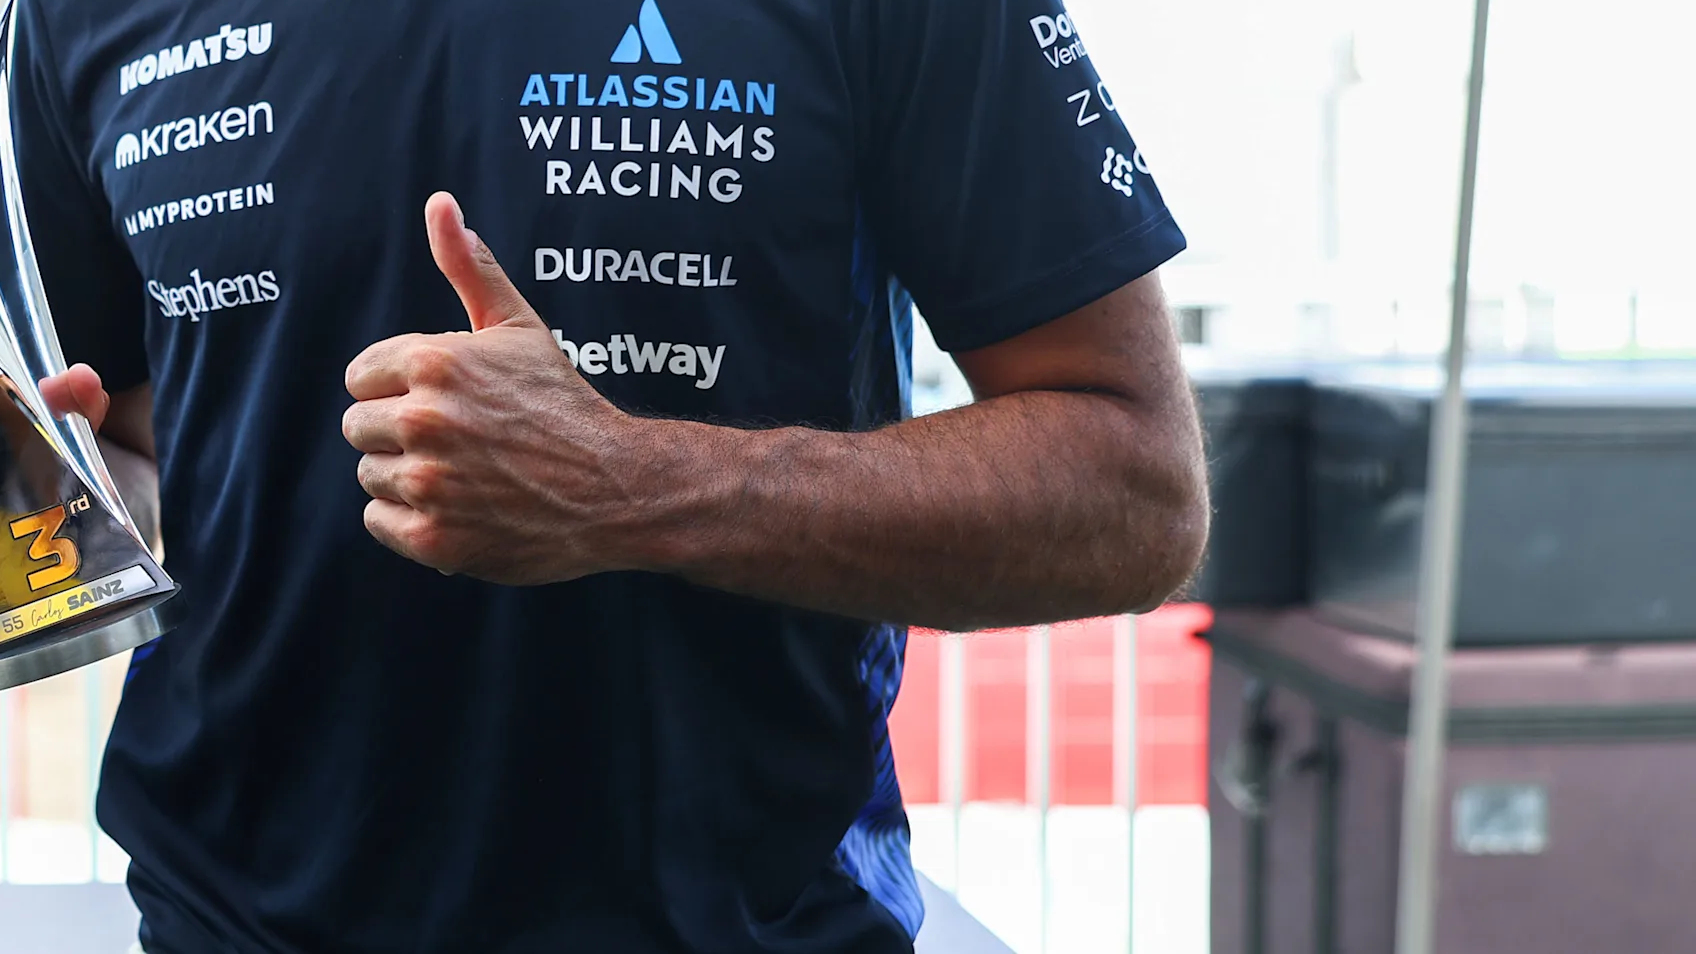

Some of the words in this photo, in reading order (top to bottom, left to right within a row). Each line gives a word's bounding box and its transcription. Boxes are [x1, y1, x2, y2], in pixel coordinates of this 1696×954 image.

[120, 22, 272, 95] KOMATSU
[519, 73, 776, 117] ATLASSIAN
[519, 116, 776, 163] WILLIAMS
[545, 160, 743, 203] RACING
[138, 183, 274, 232] MYPROTEIN
[534, 248, 738, 288] DURACELL
[148, 269, 280, 322] Stephens
[2, 614, 24, 634] 55
[67, 579, 124, 611] SAINZ
